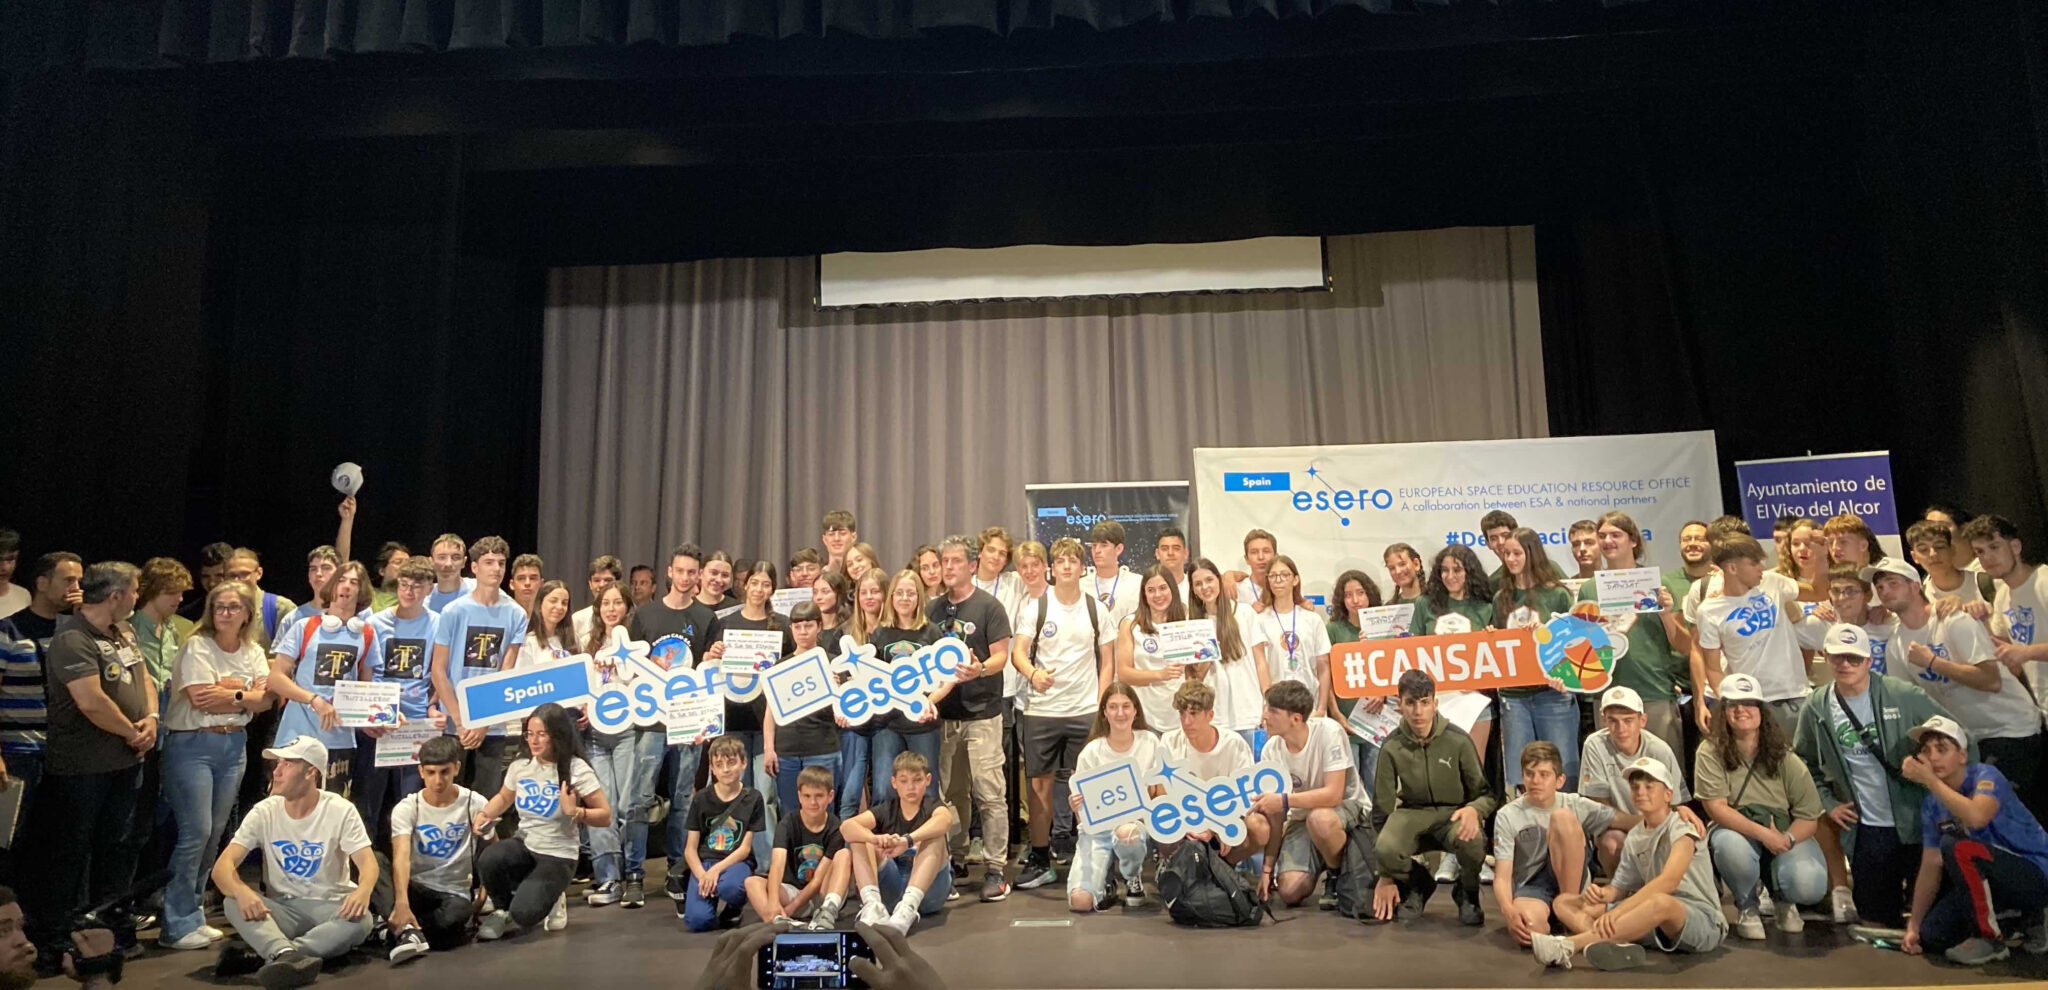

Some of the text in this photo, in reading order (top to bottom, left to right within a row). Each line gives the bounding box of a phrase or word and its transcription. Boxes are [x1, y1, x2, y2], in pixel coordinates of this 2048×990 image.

[1242, 476, 1271, 488] Spain
[1399, 476, 1691, 499] EUROPEAN SPACE EDUCATION RESOURCE OFFICE
[1747, 475, 1886, 501] Ayuntamiento de
[1292, 488, 1393, 512] esero
[1401, 493, 1658, 512] A collaboration between ESA & national partners
[1756, 499, 1881, 519] El Viso del Alcor
[1344, 639, 1521, 689] #CANSAT
[504, 680, 555, 703] Spain
[787, 676, 817, 702] .es
[840, 645, 964, 718] esero
[1096, 785, 1128, 810] .es
[1151, 768, 1285, 835] esero
